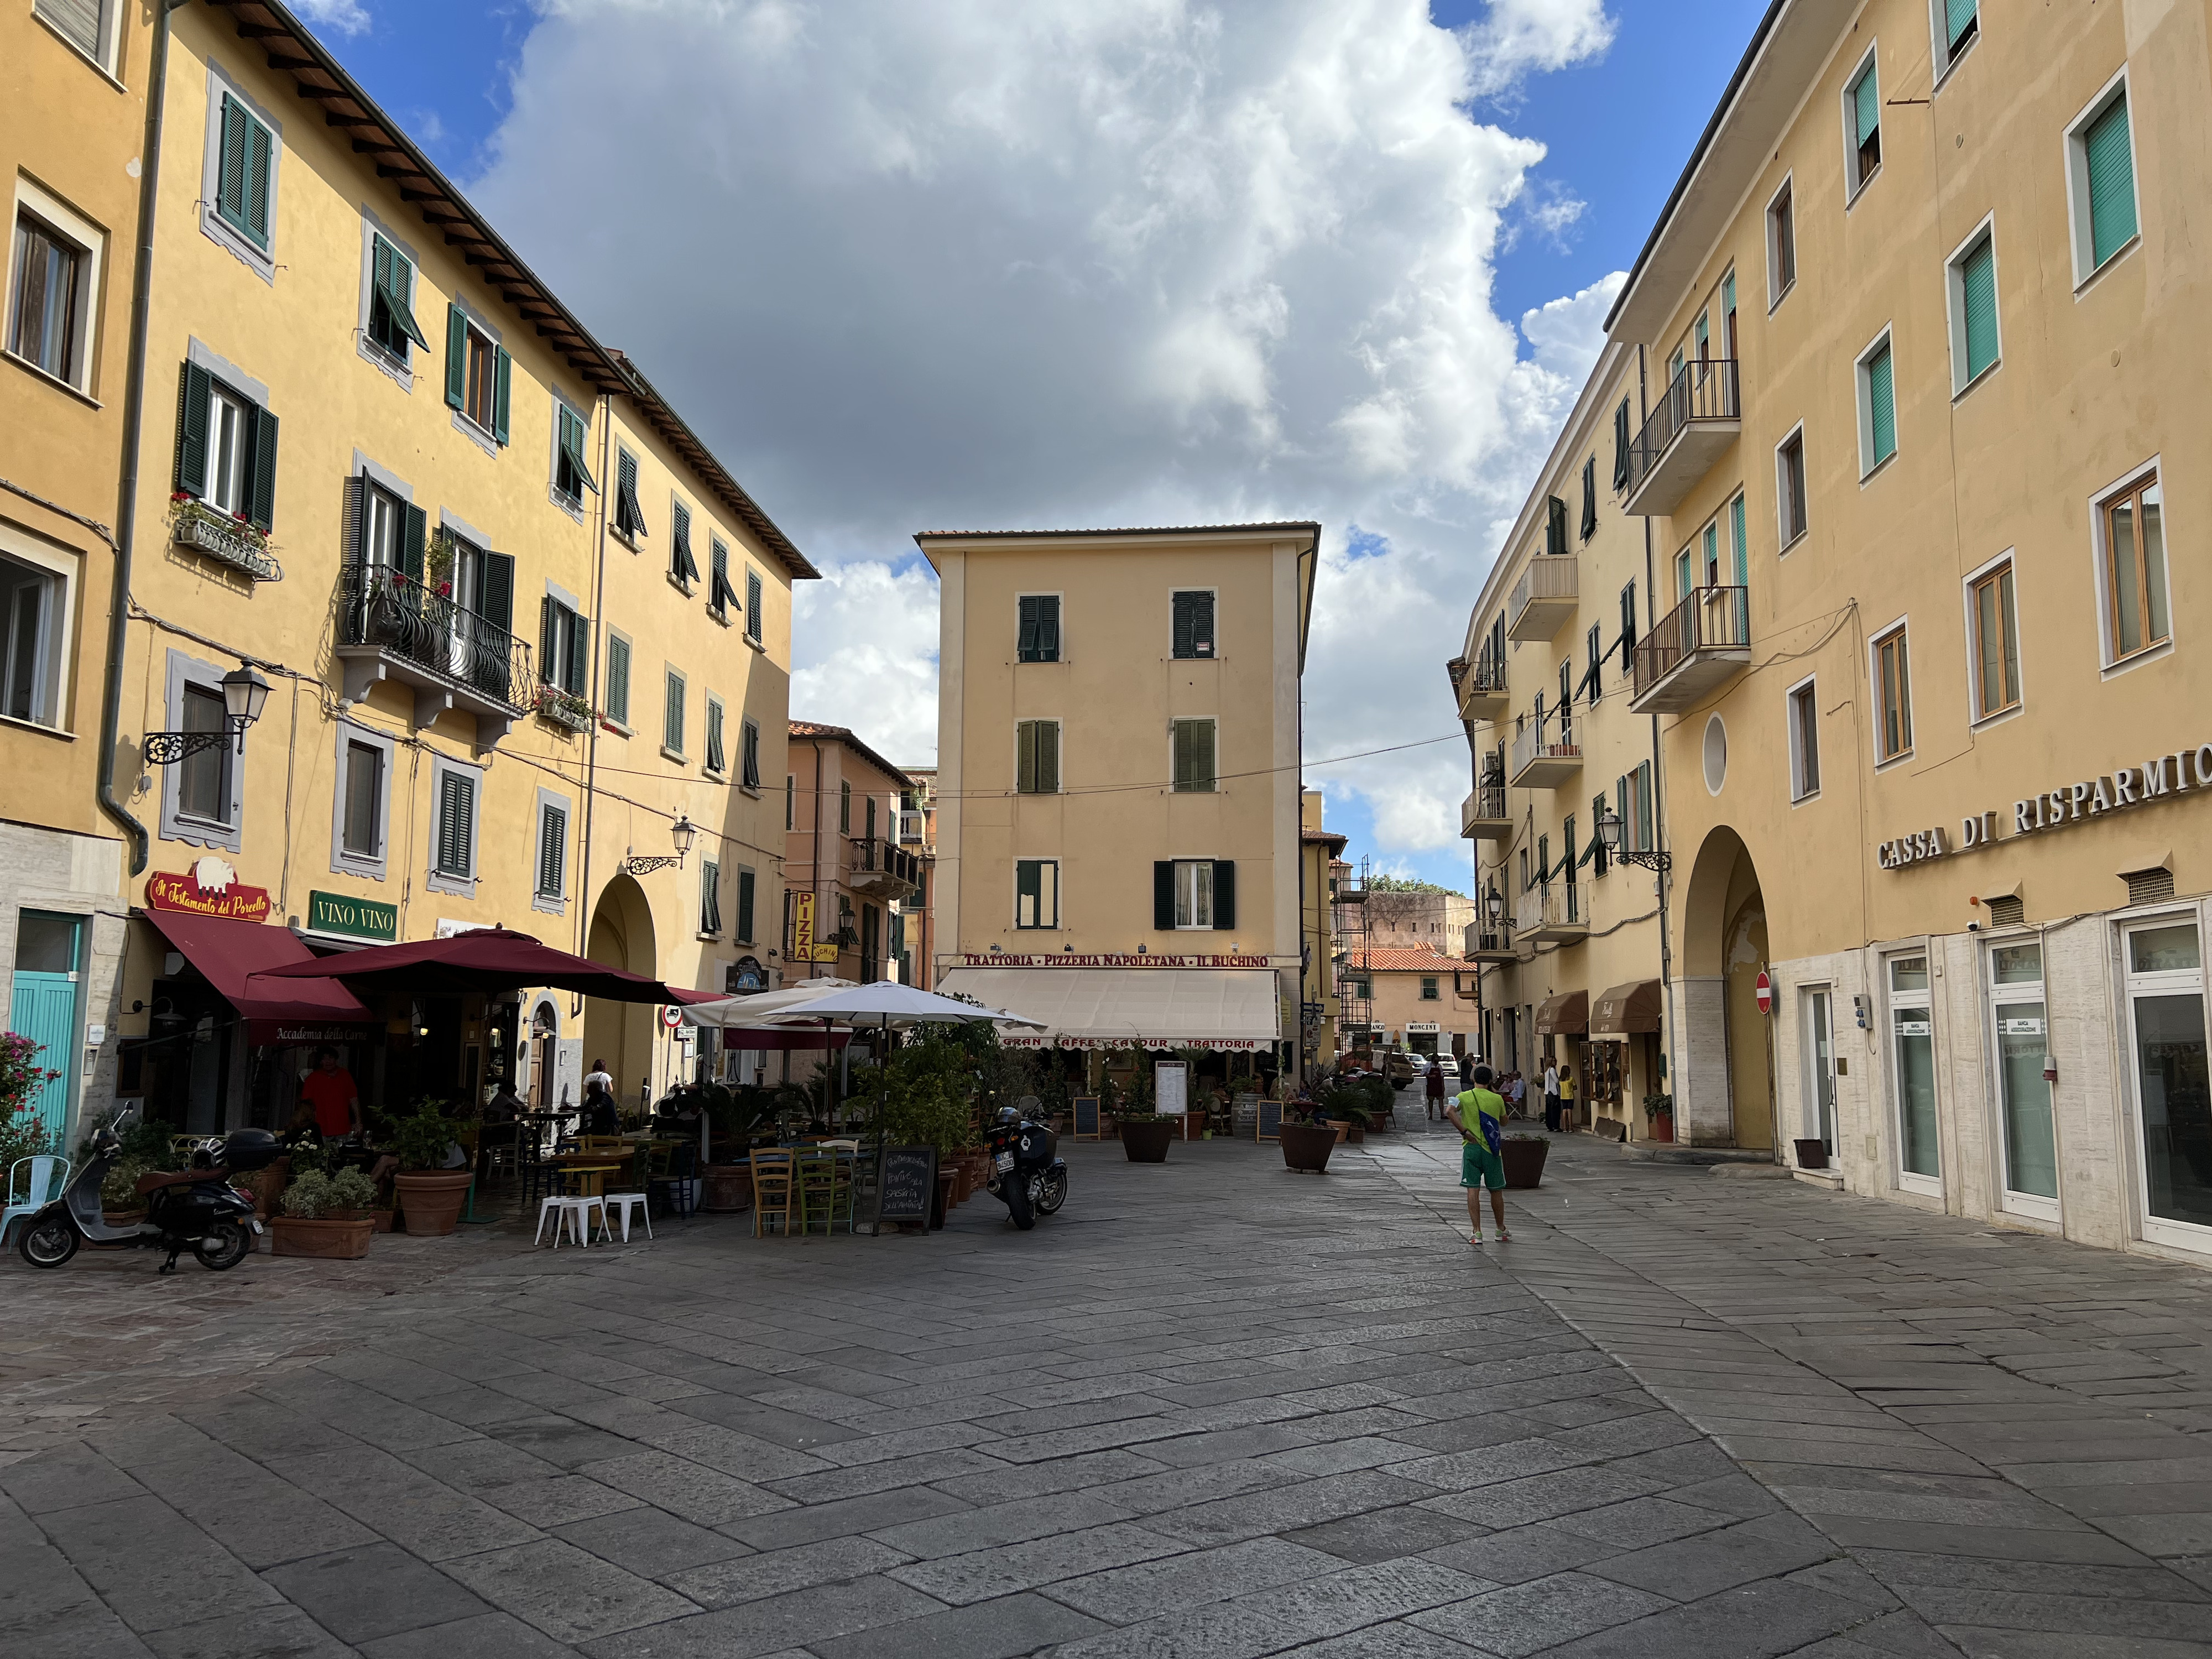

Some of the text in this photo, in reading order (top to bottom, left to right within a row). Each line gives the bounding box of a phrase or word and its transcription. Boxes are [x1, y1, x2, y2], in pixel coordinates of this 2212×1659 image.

[1877, 743, 2212, 870] CASSA DI RISPARMIO
[155, 879, 266, 915] Il Testamento del Porcello
[319, 901, 393, 931] VINO VINO
[796, 893, 812, 959] PIZZA
[812, 948, 838, 962] BUCHINO
[964, 953, 1268, 967] TRATTORIA PIZZERIA NAPOLETANA IL BUCHINO
[276, 1027, 367, 1040] Accademia della Carne
[1003, 1038, 1041, 1046] GRAN
[1055, 1037, 1100, 1047] AFFE'
[1186, 1040, 1254, 1048] TRATTORIA
[997, 1159, 1014, 1170] 94500
